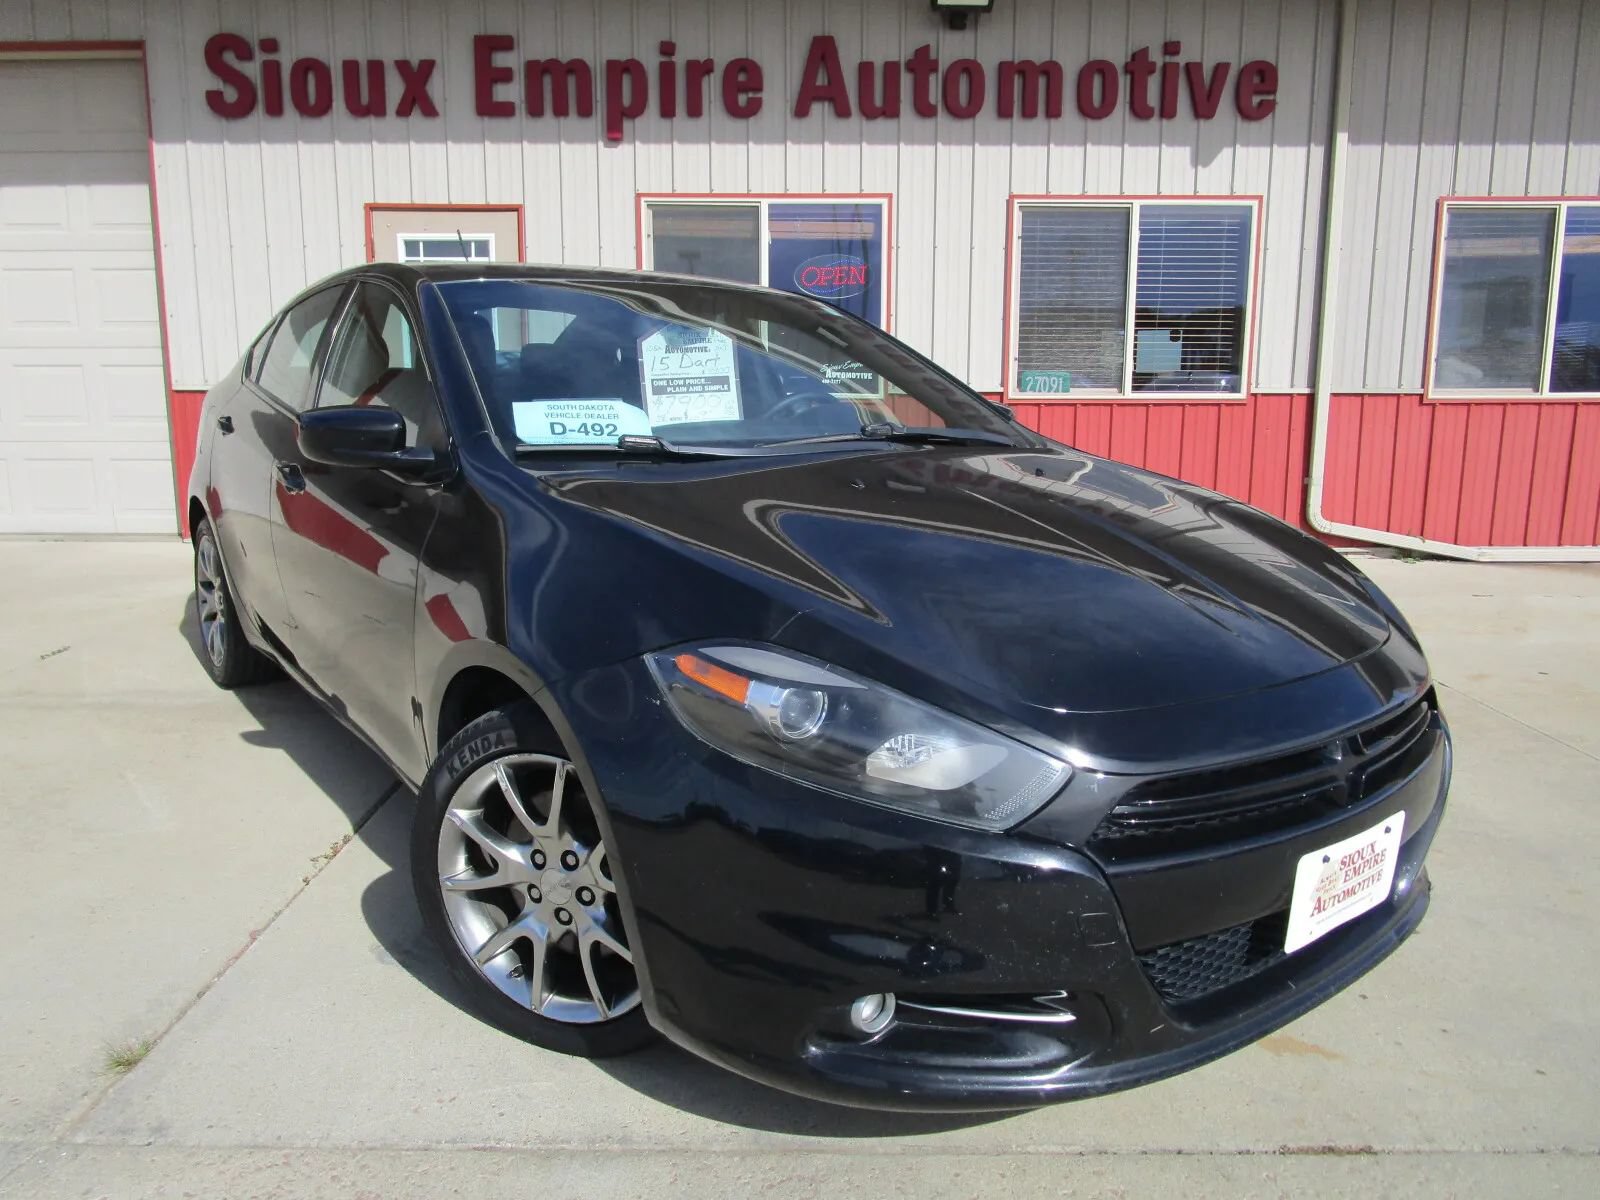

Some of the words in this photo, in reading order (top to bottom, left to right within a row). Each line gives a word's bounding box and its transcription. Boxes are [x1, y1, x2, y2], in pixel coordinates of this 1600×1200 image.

[204, 33, 439, 118] Sioux
[474, 34, 764, 141] Empire
[794, 35, 1279, 120] Automotive
[801, 263, 867, 287] OPEN
[651, 355, 670, 372] 15
[680, 352, 721, 370] Dart
[1025, 376, 1064, 392] 27091
[549, 422, 619, 437] D-492
[446, 731, 506, 780] KENDA
[1339, 840, 1377, 871] SIOUX
[1343, 848, 1388, 884] EMPIRE
[1310, 869, 1384, 917] AUTOMOTIVE
